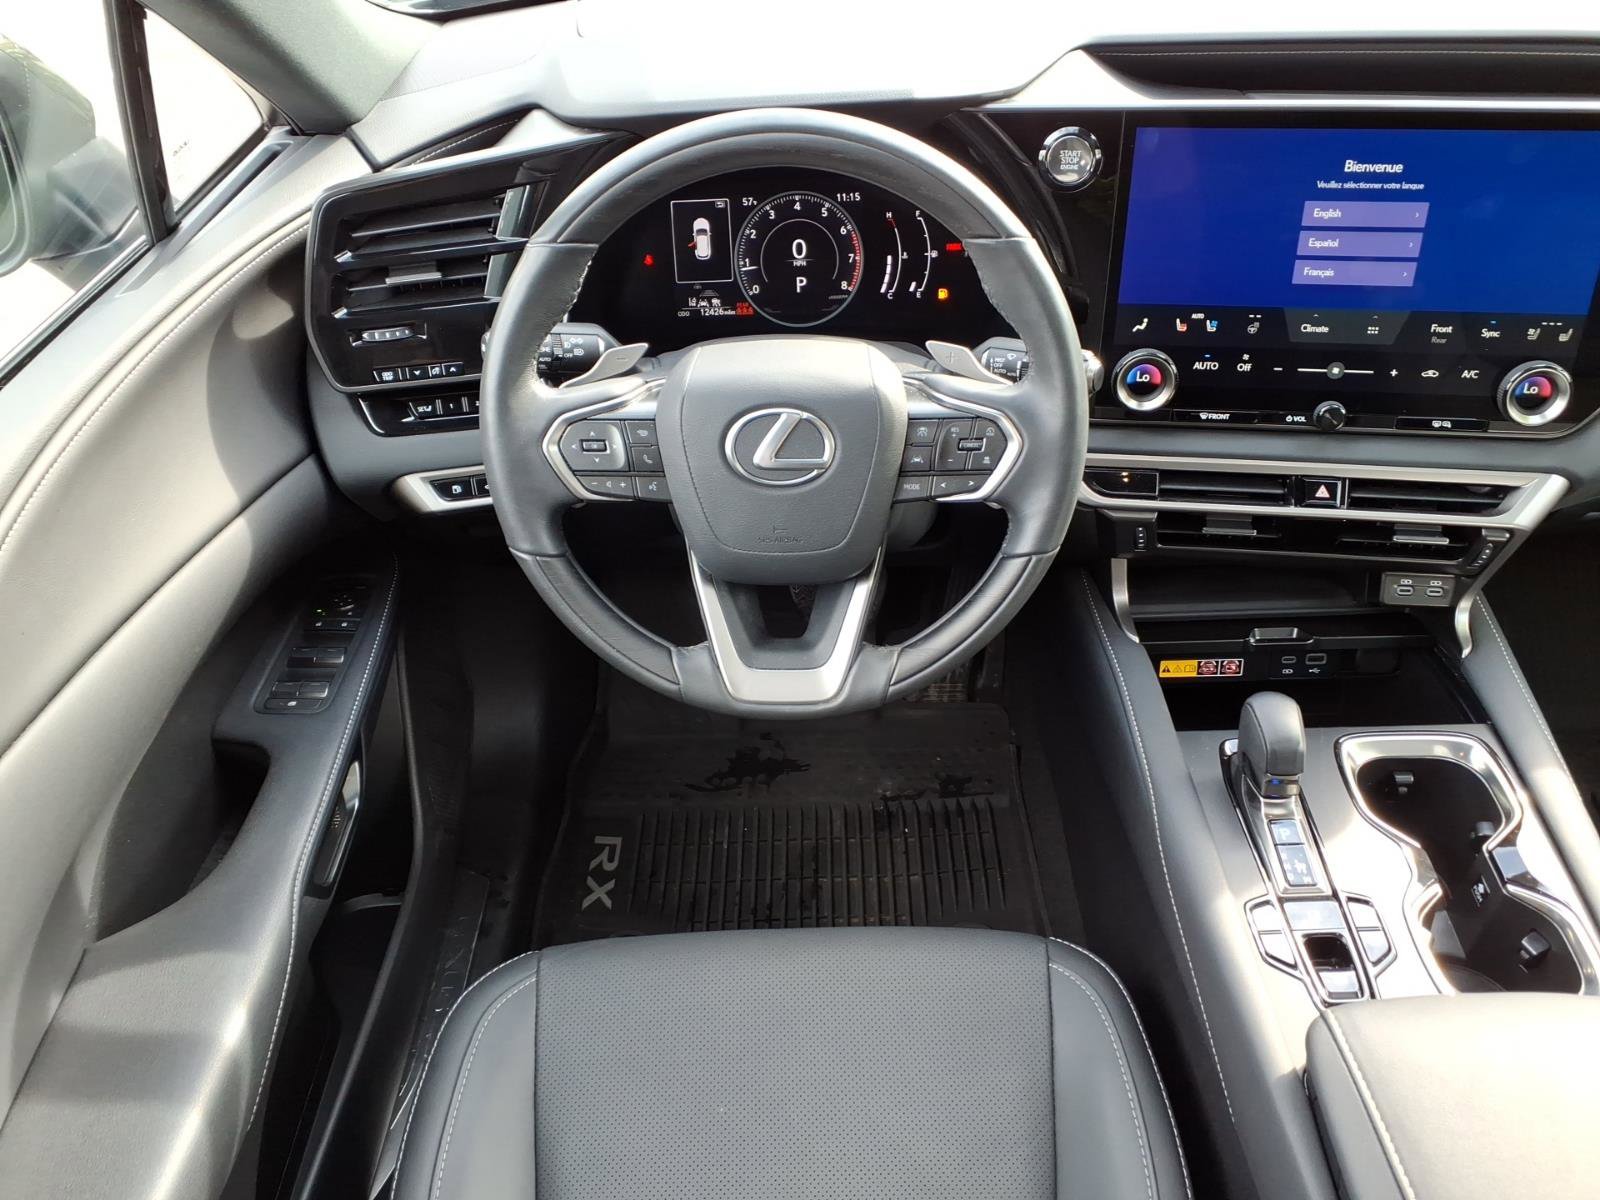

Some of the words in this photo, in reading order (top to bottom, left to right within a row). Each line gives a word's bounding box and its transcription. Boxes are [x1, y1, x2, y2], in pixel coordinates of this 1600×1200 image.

[1344, 160, 1404, 173] Bienvenue
[1317, 181, 1342, 189] Veuillez
[1343, 181, 1382, 189] sélectionner
[1402, 182, 1425, 191] langue
[836, 192, 861, 202] 11:15
[793, 202, 801, 211] 4
[768, 210, 775, 219] 3
[821, 208, 828, 217] 5
[1313, 208, 1342, 219] English
[750, 229, 757, 238] 2
[840, 226, 847, 235] 6
[1308, 238, 1340, 248] Español
[792, 239, 807, 260] 0
[745, 258, 750, 267] 1
[848, 254, 855, 263] 7
[1303, 267, 1335, 278] Français
[752, 285, 759, 294] 0
[796, 277, 807, 293] P
[841, 281, 848, 290] 8
[700, 308, 724, 316] 12426
[1300, 323, 1330, 333] Climate
[1430, 324, 1454, 334] Front
[1481, 328, 1501, 338] Sync
[1431, 336, 1447, 344] Rear
[1193, 362, 1219, 371] AUTO
[1237, 363, 1252, 371] Off
[1136, 371, 1150, 382] Lo
[1461, 370, 1479, 379] A/C
[1523, 384, 1539, 395] Lo
[1280, 828, 1290, 840] P
[581, 835, 623, 911] RX
